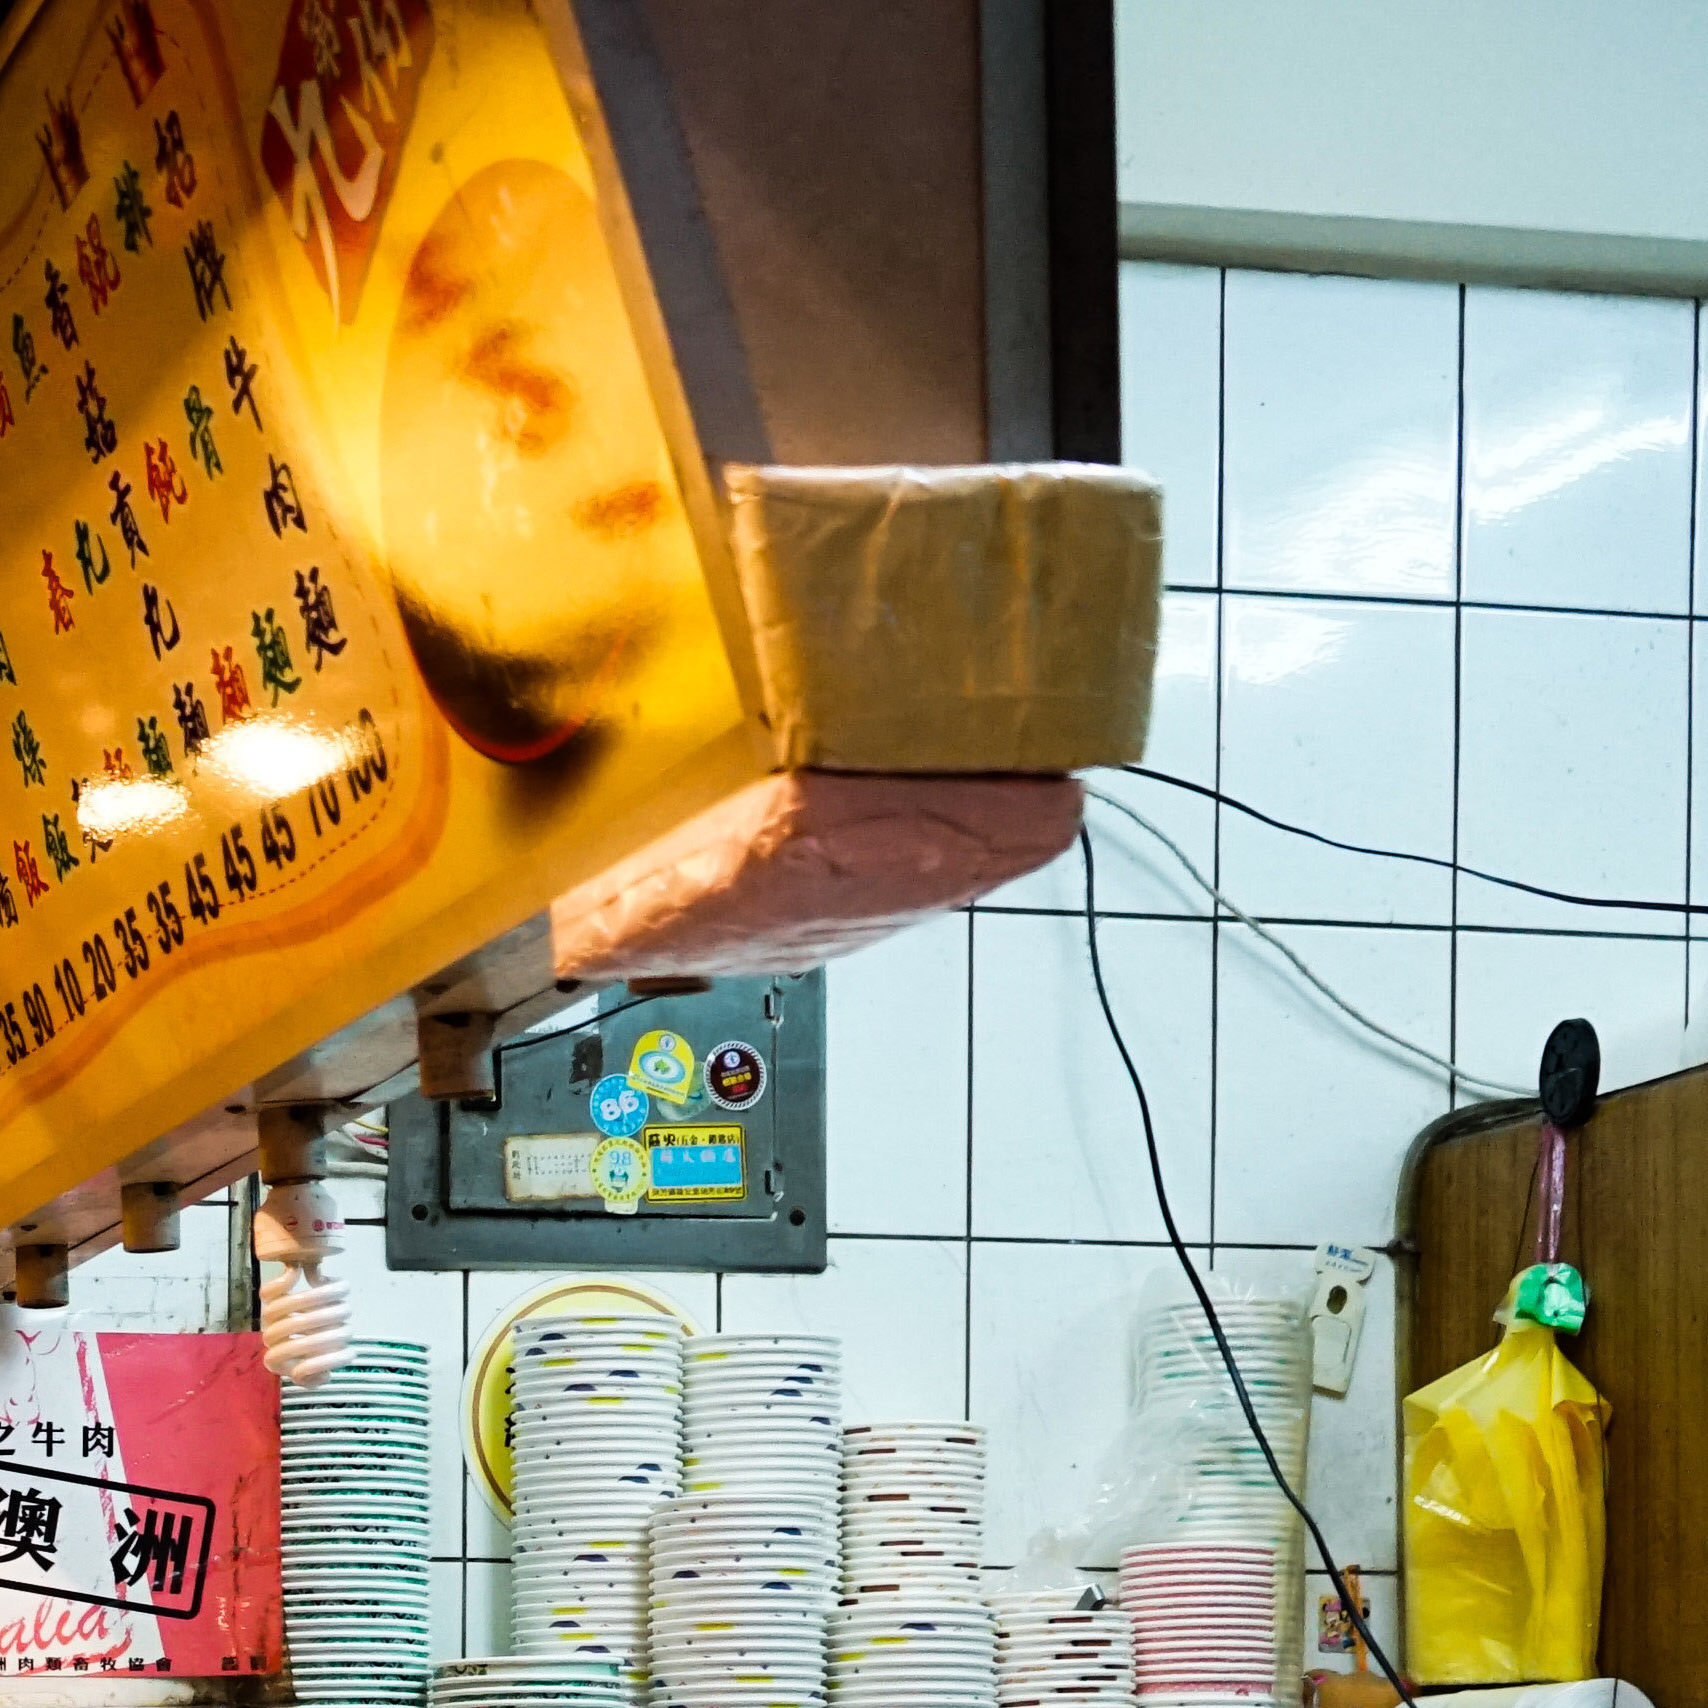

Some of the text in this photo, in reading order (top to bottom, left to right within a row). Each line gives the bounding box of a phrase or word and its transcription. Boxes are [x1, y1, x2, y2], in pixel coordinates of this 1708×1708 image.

[155, 114, 343, 667] 招牌牛肉麵
[115, 164, 299, 704] 排骨麵
[77, 216, 295, 868] 餛飩麵 45
[13, 315, 220, 923] 魚丸麵 45
[46, 264, 256, 902] 香菇貢丸麵 45
[114, 907, 149, 978] 35
[147, 881, 183, 953] 35
[54, 959, 85, 1022] 10
[82, 934, 115, 1001] 20
[23, 984, 55, 1046] 90
[601, 1090, 639, 1122] 86
